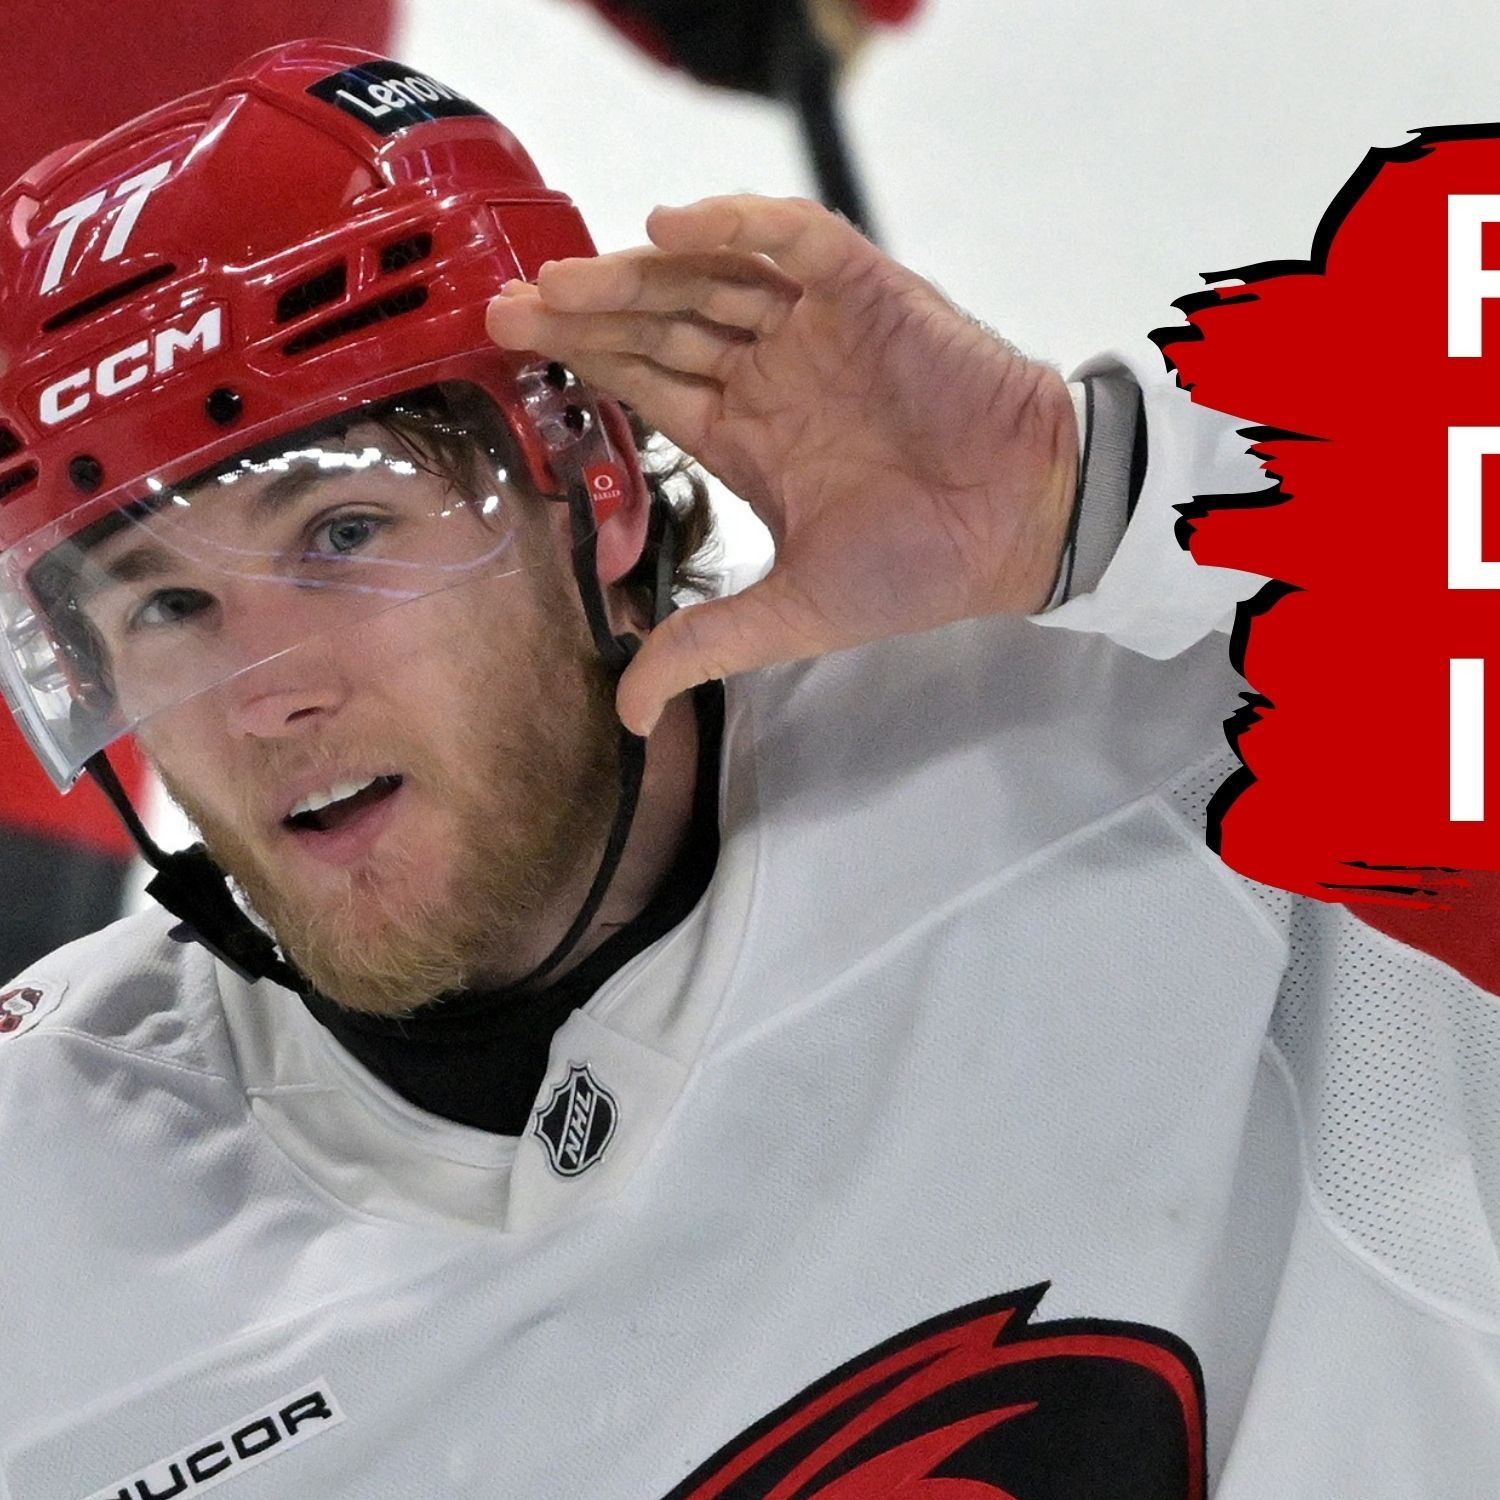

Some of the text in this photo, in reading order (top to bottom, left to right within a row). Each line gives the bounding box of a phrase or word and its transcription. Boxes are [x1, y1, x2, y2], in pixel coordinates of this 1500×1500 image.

[336, 75, 470, 117] Lenov
[40, 160, 172, 295] 77
[40, 307, 221, 424] CCM
[564, 1091, 592, 1165] NHL
